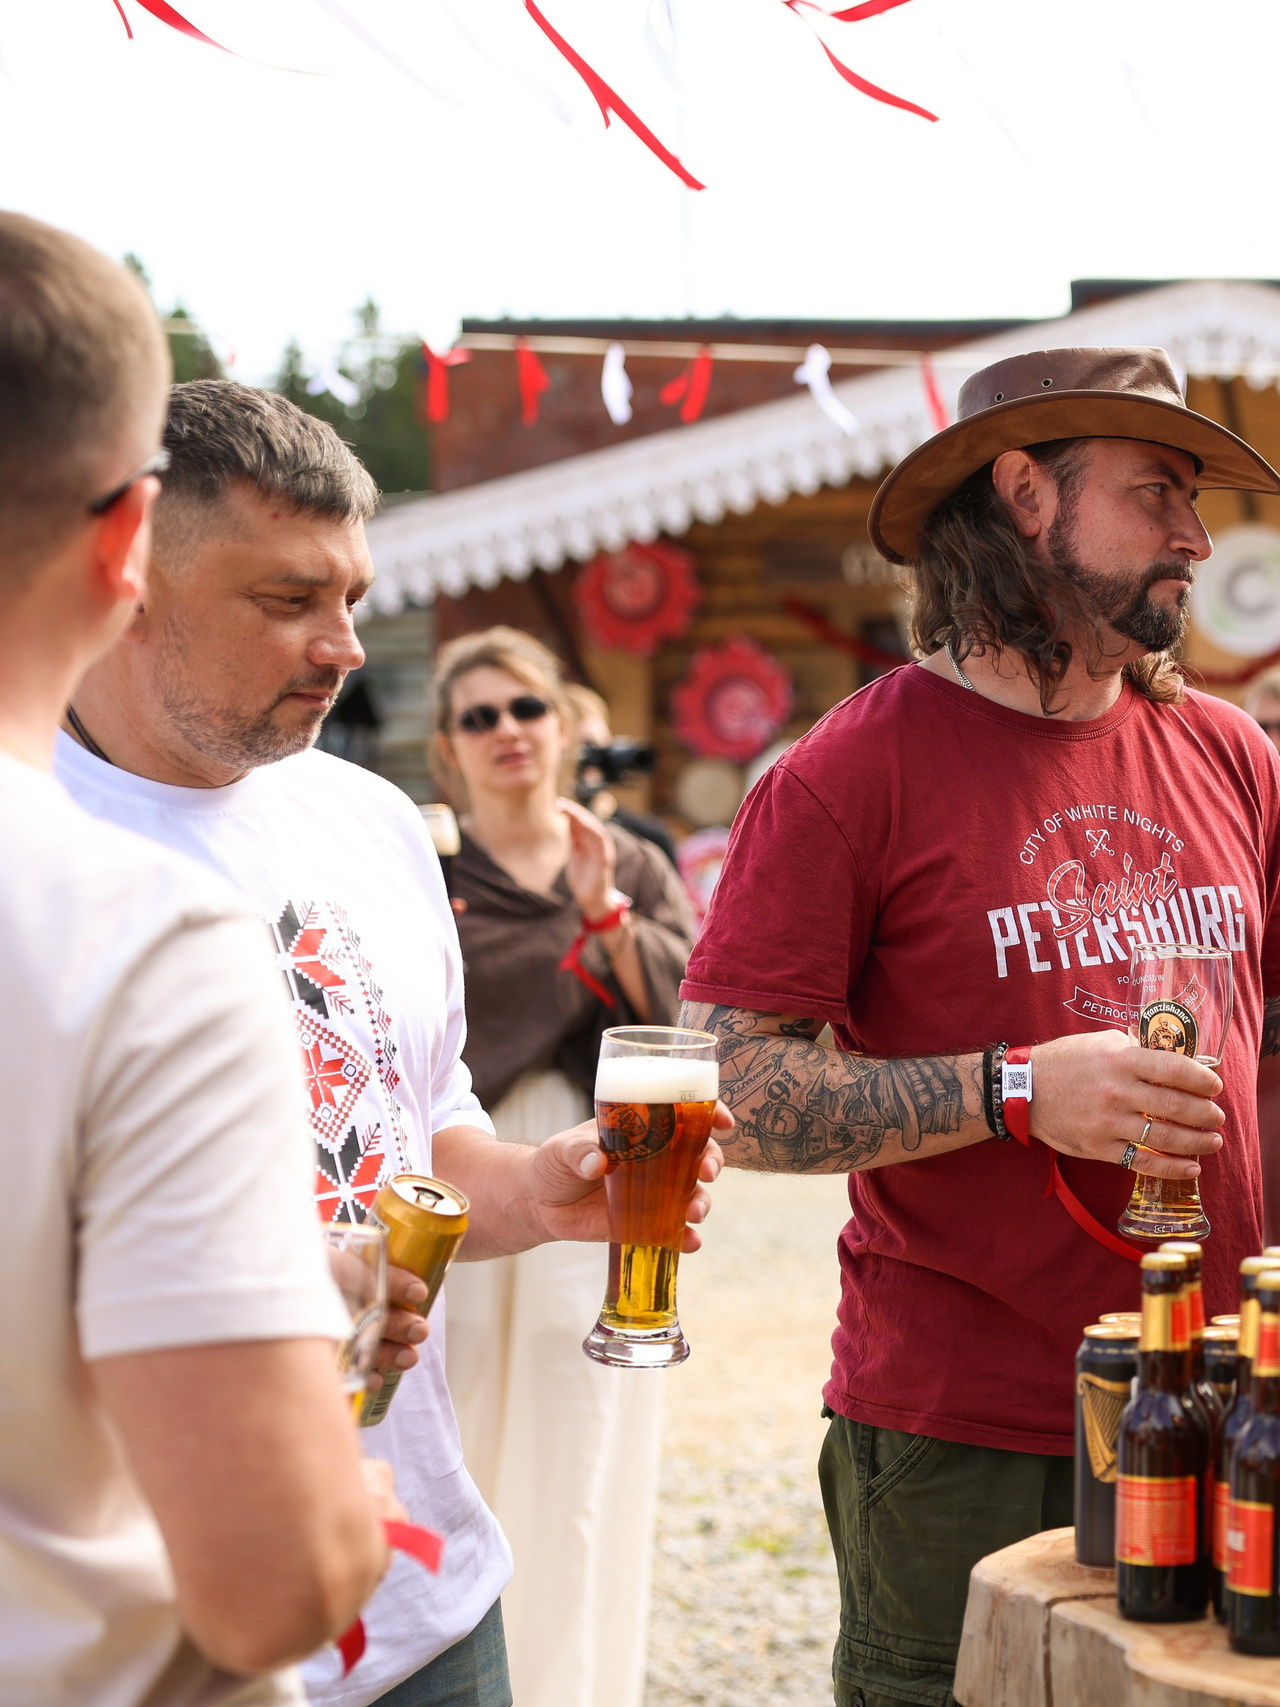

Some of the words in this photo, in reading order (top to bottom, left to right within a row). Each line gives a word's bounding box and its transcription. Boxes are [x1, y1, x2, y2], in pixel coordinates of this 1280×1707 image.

[1019, 828, 1046, 865] CITY
[1043, 812, 1063, 833] OF
[1065, 804, 1118, 822] WHITE
[1123, 808, 1185, 852] NIGHTS
[986, 885, 1246, 978] PETERSBURG
[1047, 852, 1178, 938] Saint
